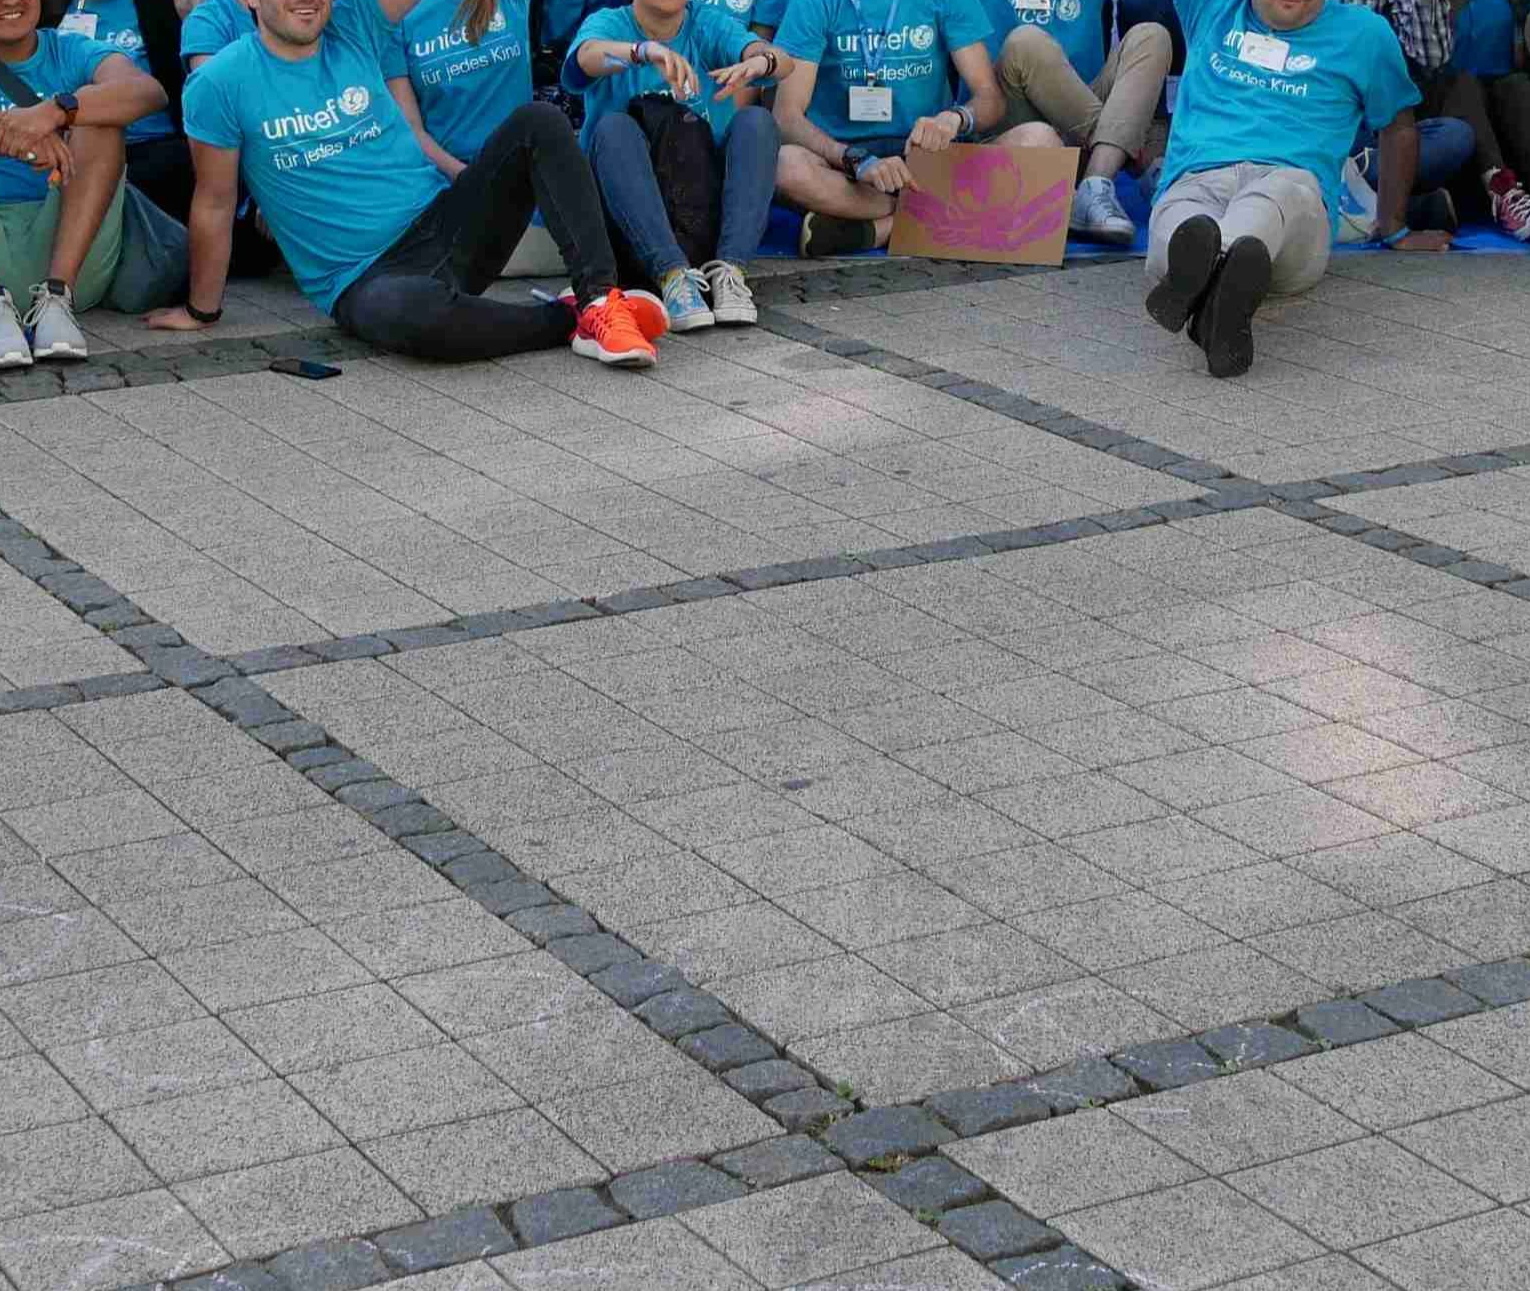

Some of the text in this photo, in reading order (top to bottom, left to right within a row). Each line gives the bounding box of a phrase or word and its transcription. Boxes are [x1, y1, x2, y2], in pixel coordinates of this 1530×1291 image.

[414, 25, 470, 60] unice
[420, 41, 522, 88] für jedes Kind
[905, 60, 933, 78] Kind
[1270, 75, 1308, 97] Kind
[262, 105, 341, 140] unicef
[274, 123, 383, 171] für jedes Kind
